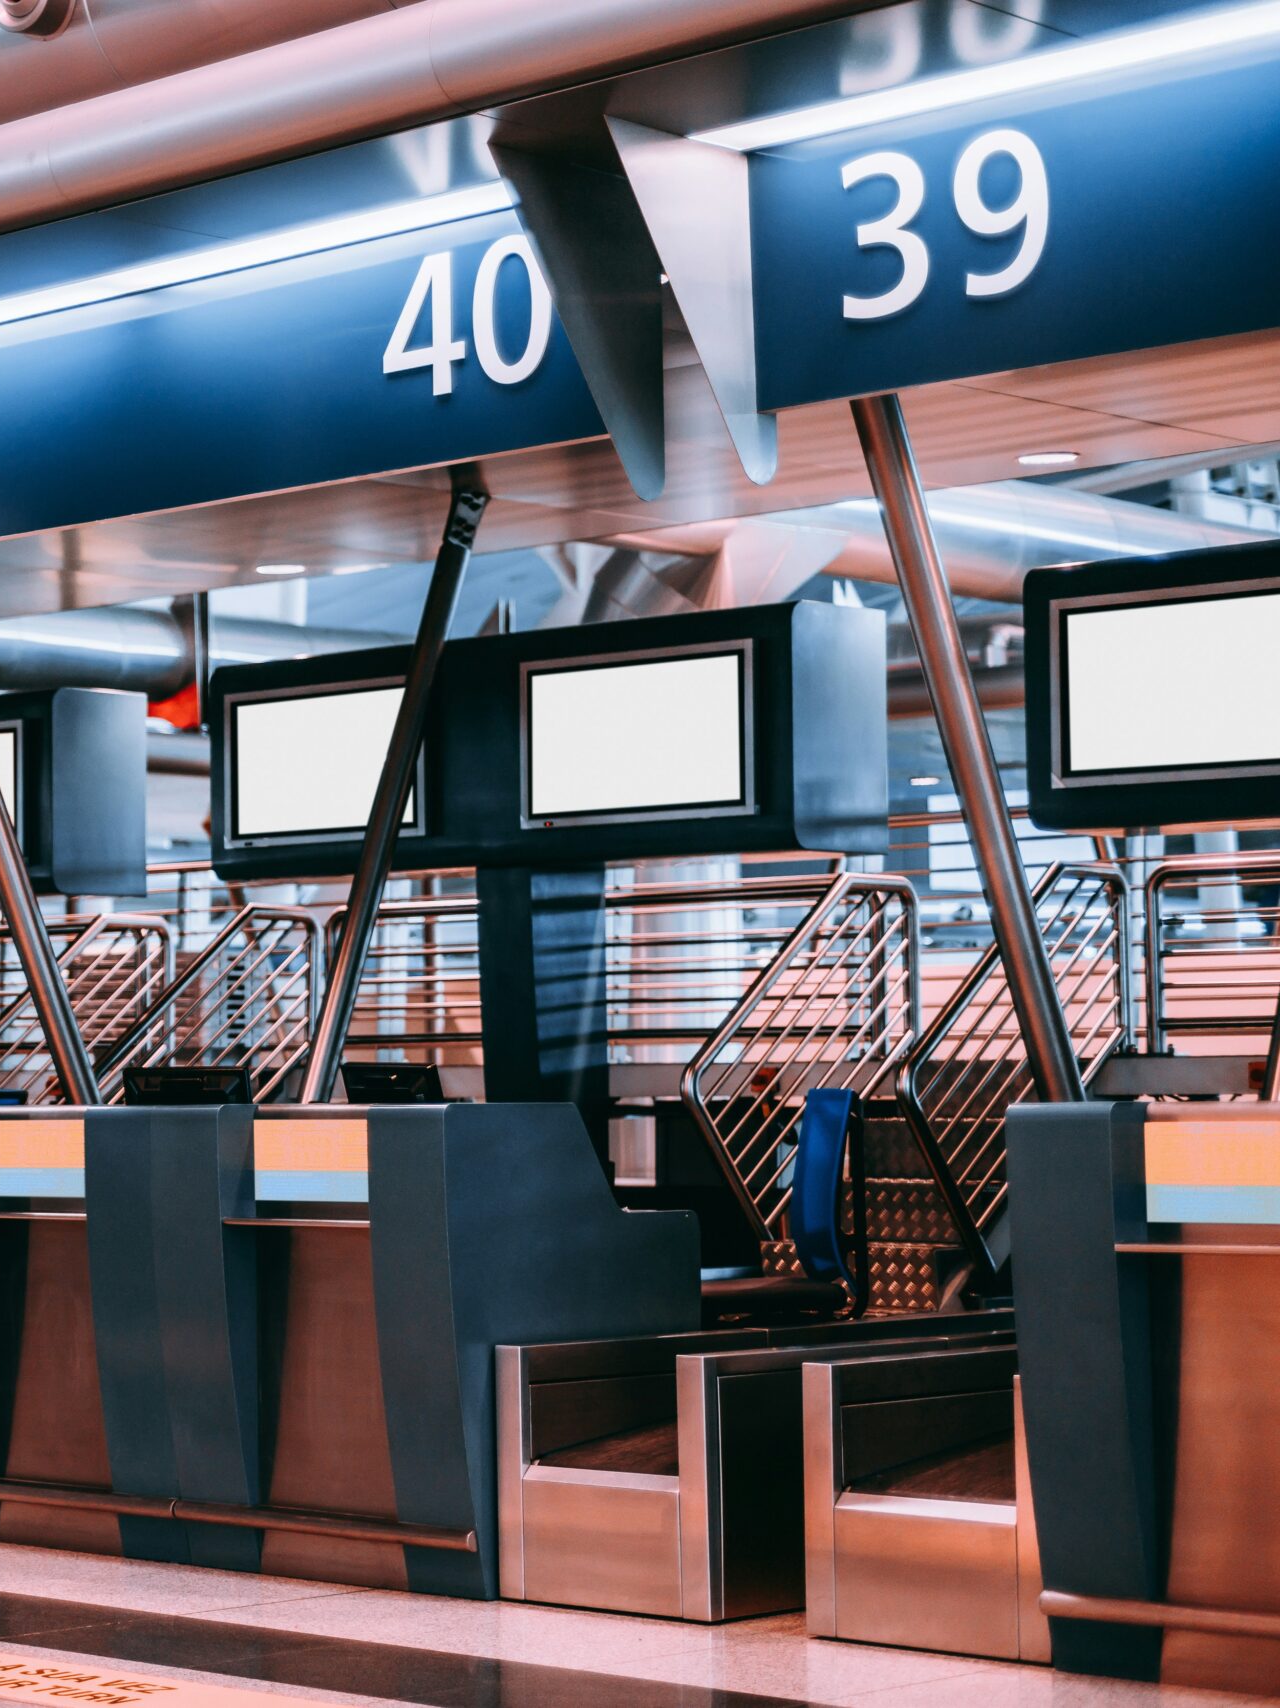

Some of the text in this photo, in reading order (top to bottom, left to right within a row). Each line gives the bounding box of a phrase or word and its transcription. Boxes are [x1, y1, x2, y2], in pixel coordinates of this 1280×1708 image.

[840, 129, 1051, 320] 39
[382, 234, 553, 396] 40
[21, 1667, 101, 1683] SUA
[97, 1679, 178, 1694] VEZ
[32, 1684, 144, 1705] TURN
